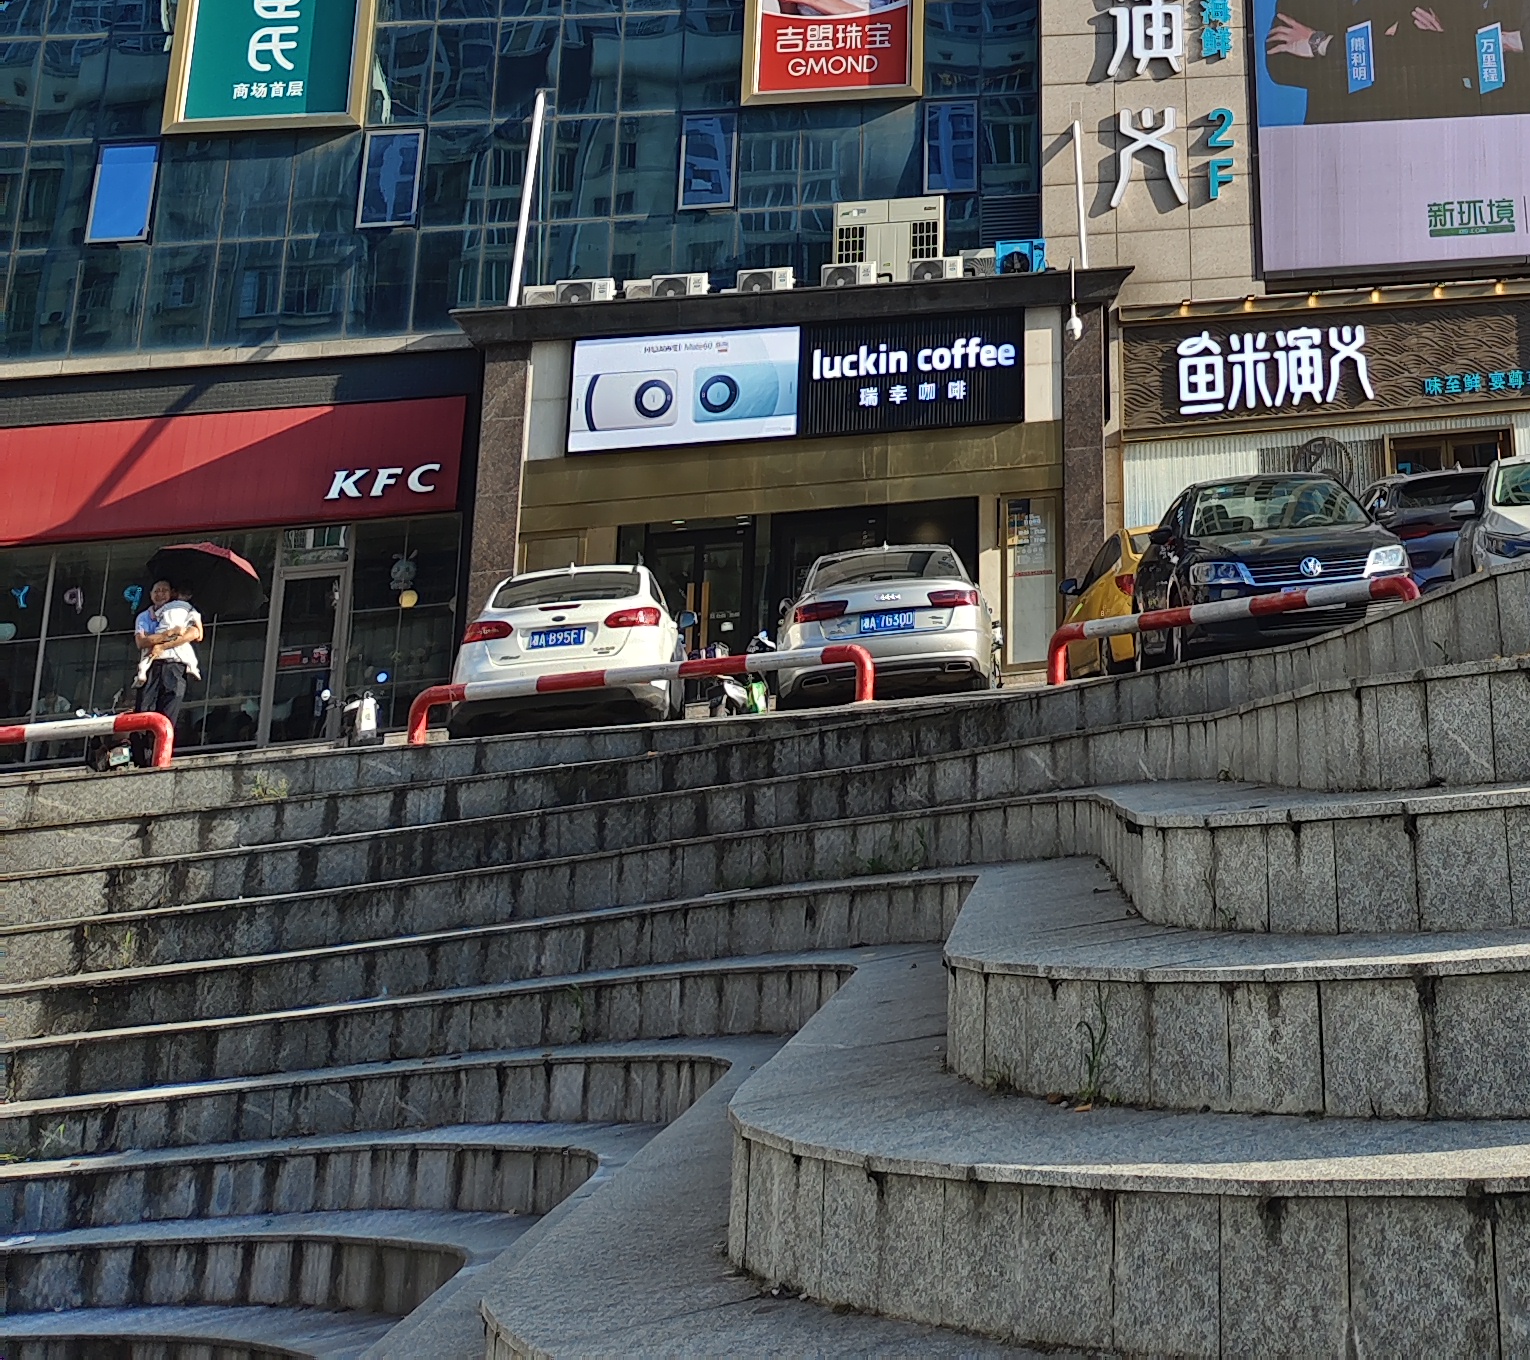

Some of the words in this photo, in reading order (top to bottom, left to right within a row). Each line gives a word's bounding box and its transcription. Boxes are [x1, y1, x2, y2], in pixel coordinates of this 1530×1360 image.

[776, 23, 892, 53] 吉盟珠宝
[788, 55, 878, 77] GMOND
[1481, 39, 1498, 82] 万里程
[232, 81, 304, 100] 商场首层
[1206, 108, 1234, 200] 2F
[1427, 198, 1515, 228] 新环境
[813, 344, 908, 380] luckin
[917, 337, 1016, 372] coffee
[859, 380, 967, 407] 瑞幸咖啡
[1423, 372, 1480, 397] 味至鲜
[325, 463, 441, 500] KFC
